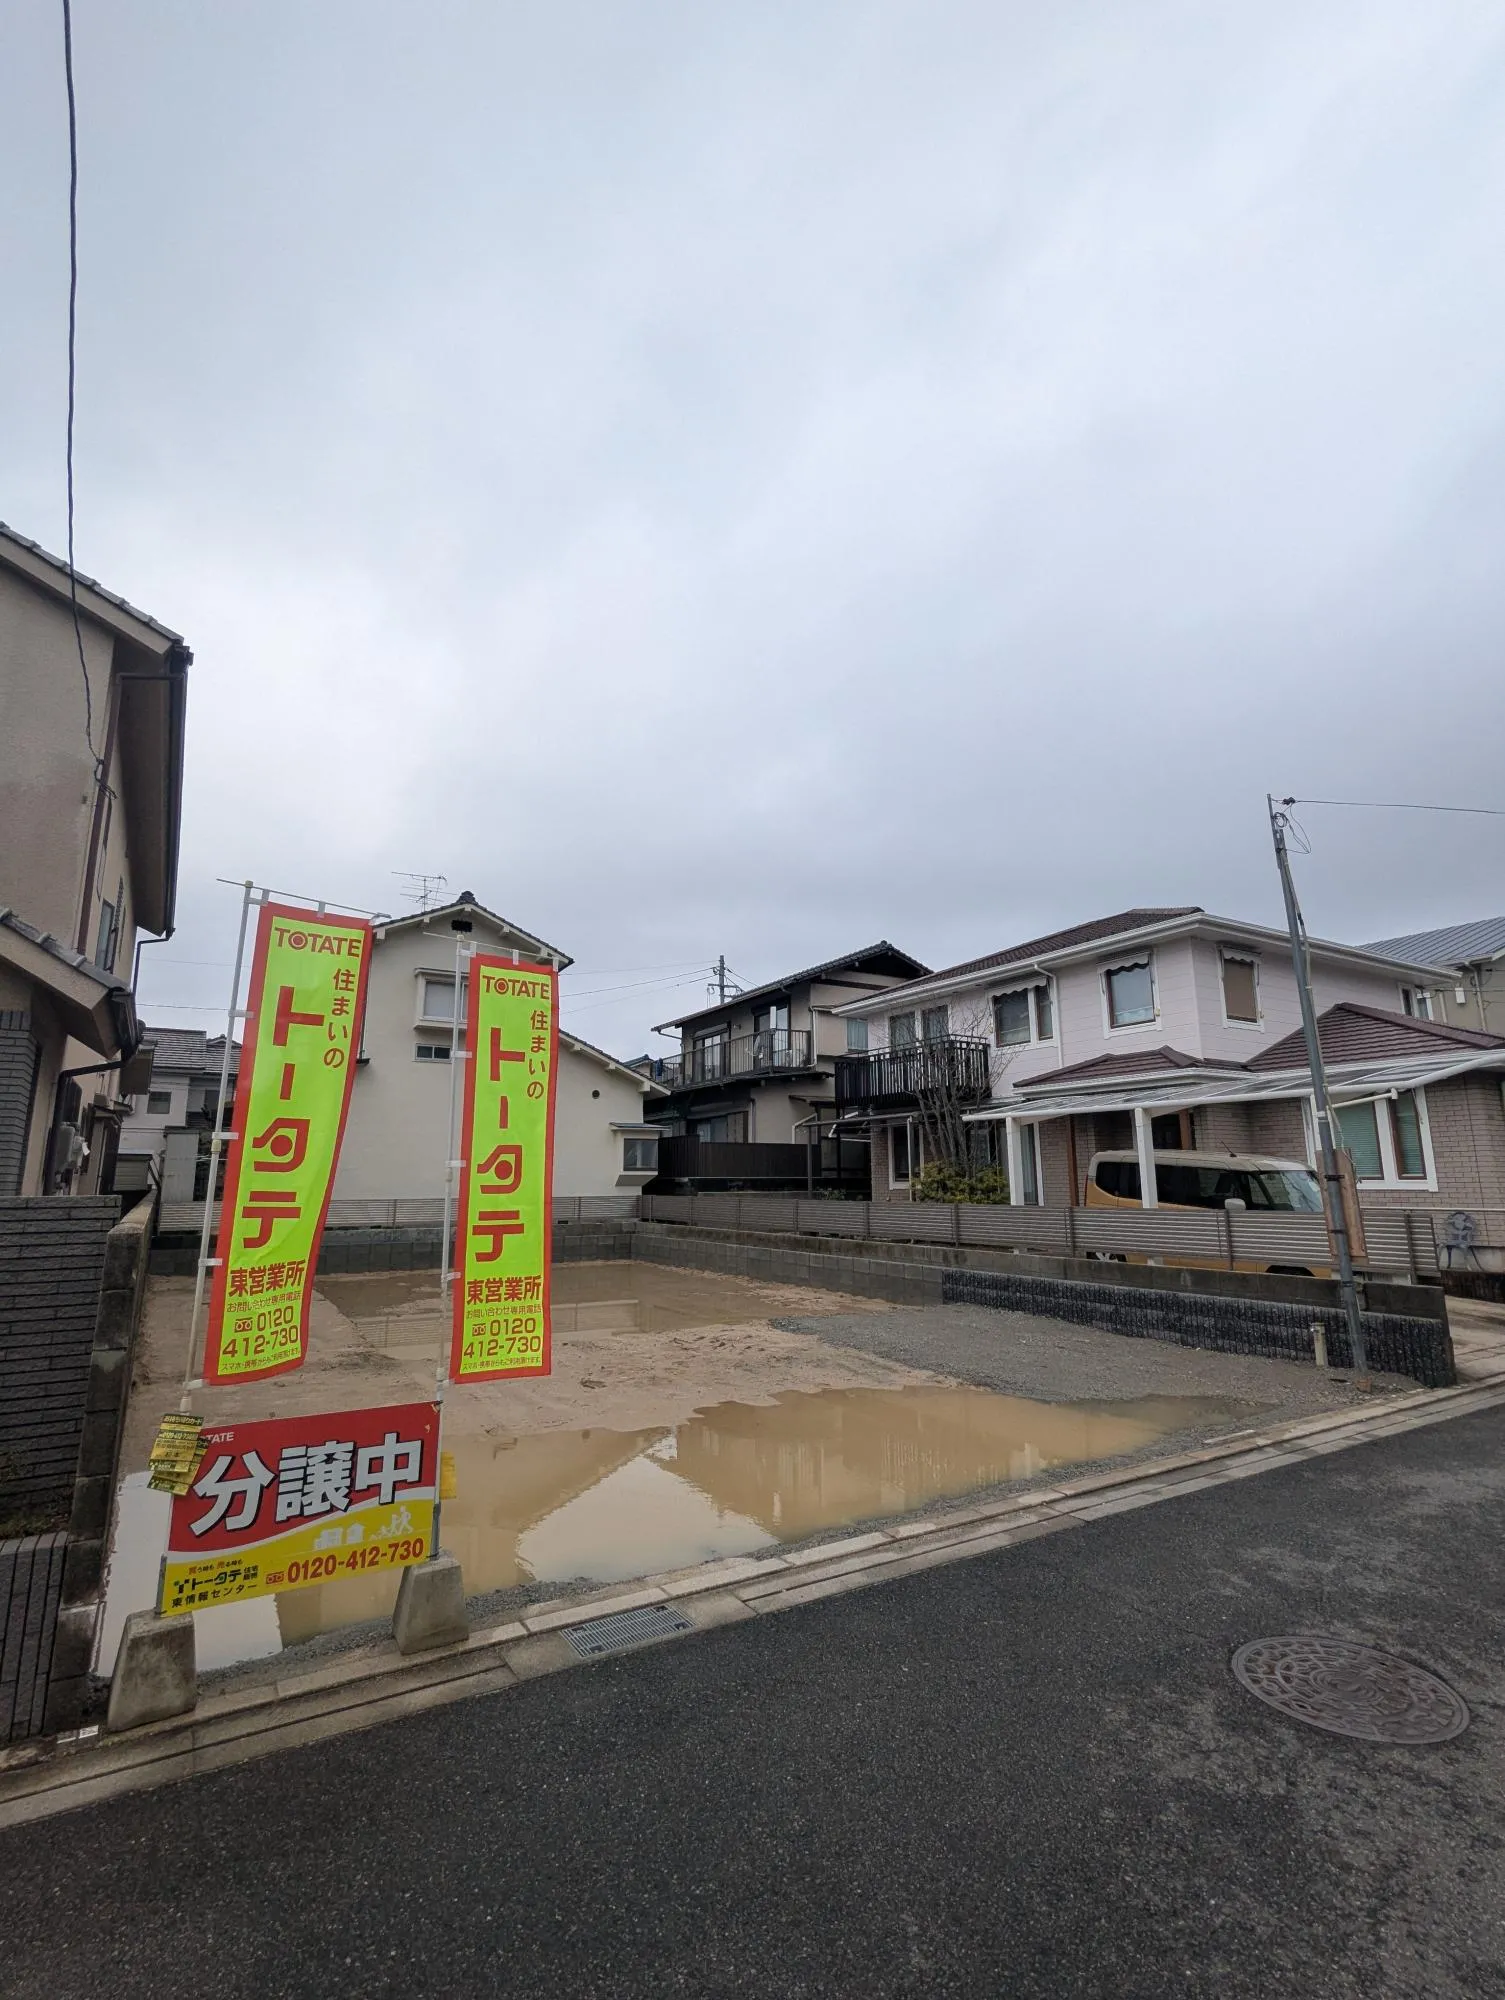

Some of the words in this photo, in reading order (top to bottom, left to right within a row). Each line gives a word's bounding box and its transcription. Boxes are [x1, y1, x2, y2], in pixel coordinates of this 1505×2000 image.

[274, 927, 362, 958] TOTATE
[482, 975, 550, 1000] TOTATE
[323, 968, 356, 1069] 住まいの
[527, 1010, 549, 1100] 住まいの
[242, 985, 326, 1249] トータテ
[472, 1027, 526, 1263] トータテ
[228, 1258, 306, 1298] 東営業所
[466, 1274, 542, 1306] 東営業所
[256, 1305, 294, 1332] 0120
[489, 1317, 537, 1337] 0120
[222, 1324, 299, 1358] 412-730
[463, 1335, 542, 1359] 412-730
[189, 1431, 424, 1537] 分譲中
[287, 1537, 424, 1583] 0120-412-730
[171, 1584, 258, 1609] 東情報センター
